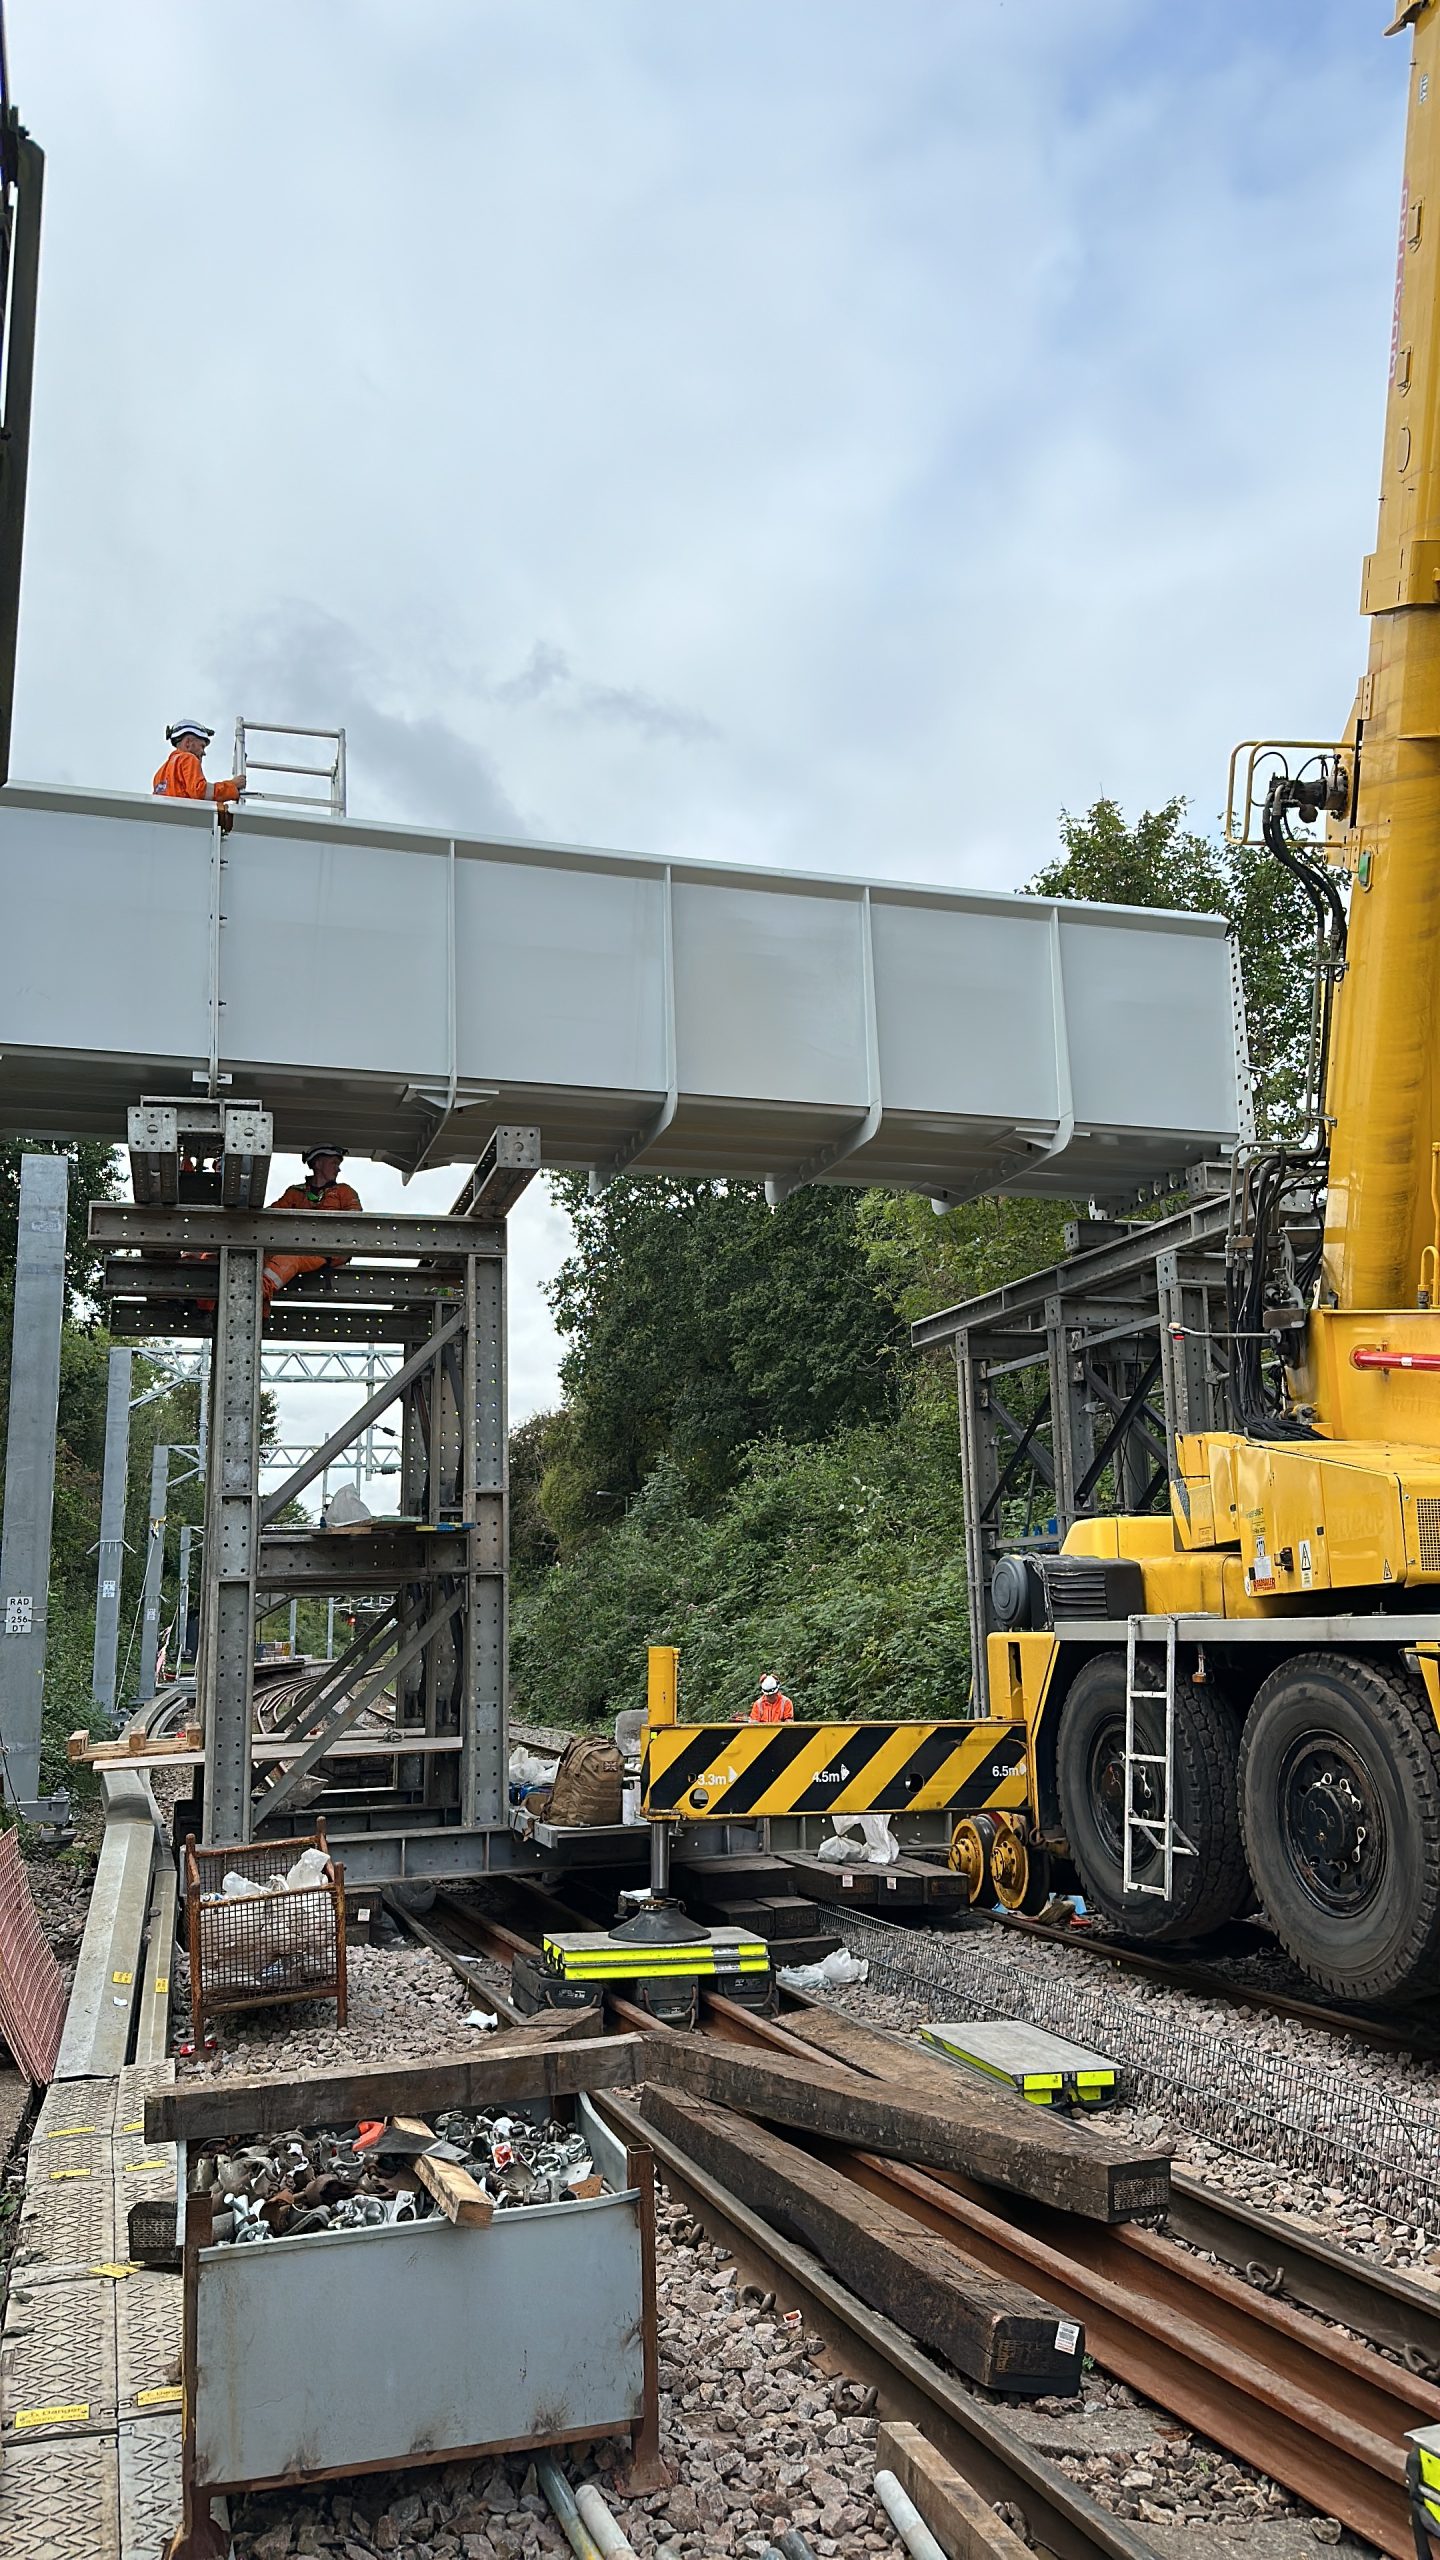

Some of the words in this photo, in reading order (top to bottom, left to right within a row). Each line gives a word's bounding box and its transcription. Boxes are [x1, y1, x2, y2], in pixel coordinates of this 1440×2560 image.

[11, 1598, 29, 1606] RAD
[812, 1770, 840, 1783] 4.5m
[992, 1765, 1020, 1777] 6.5m
[697, 1773, 727, 1786] 3.3m
